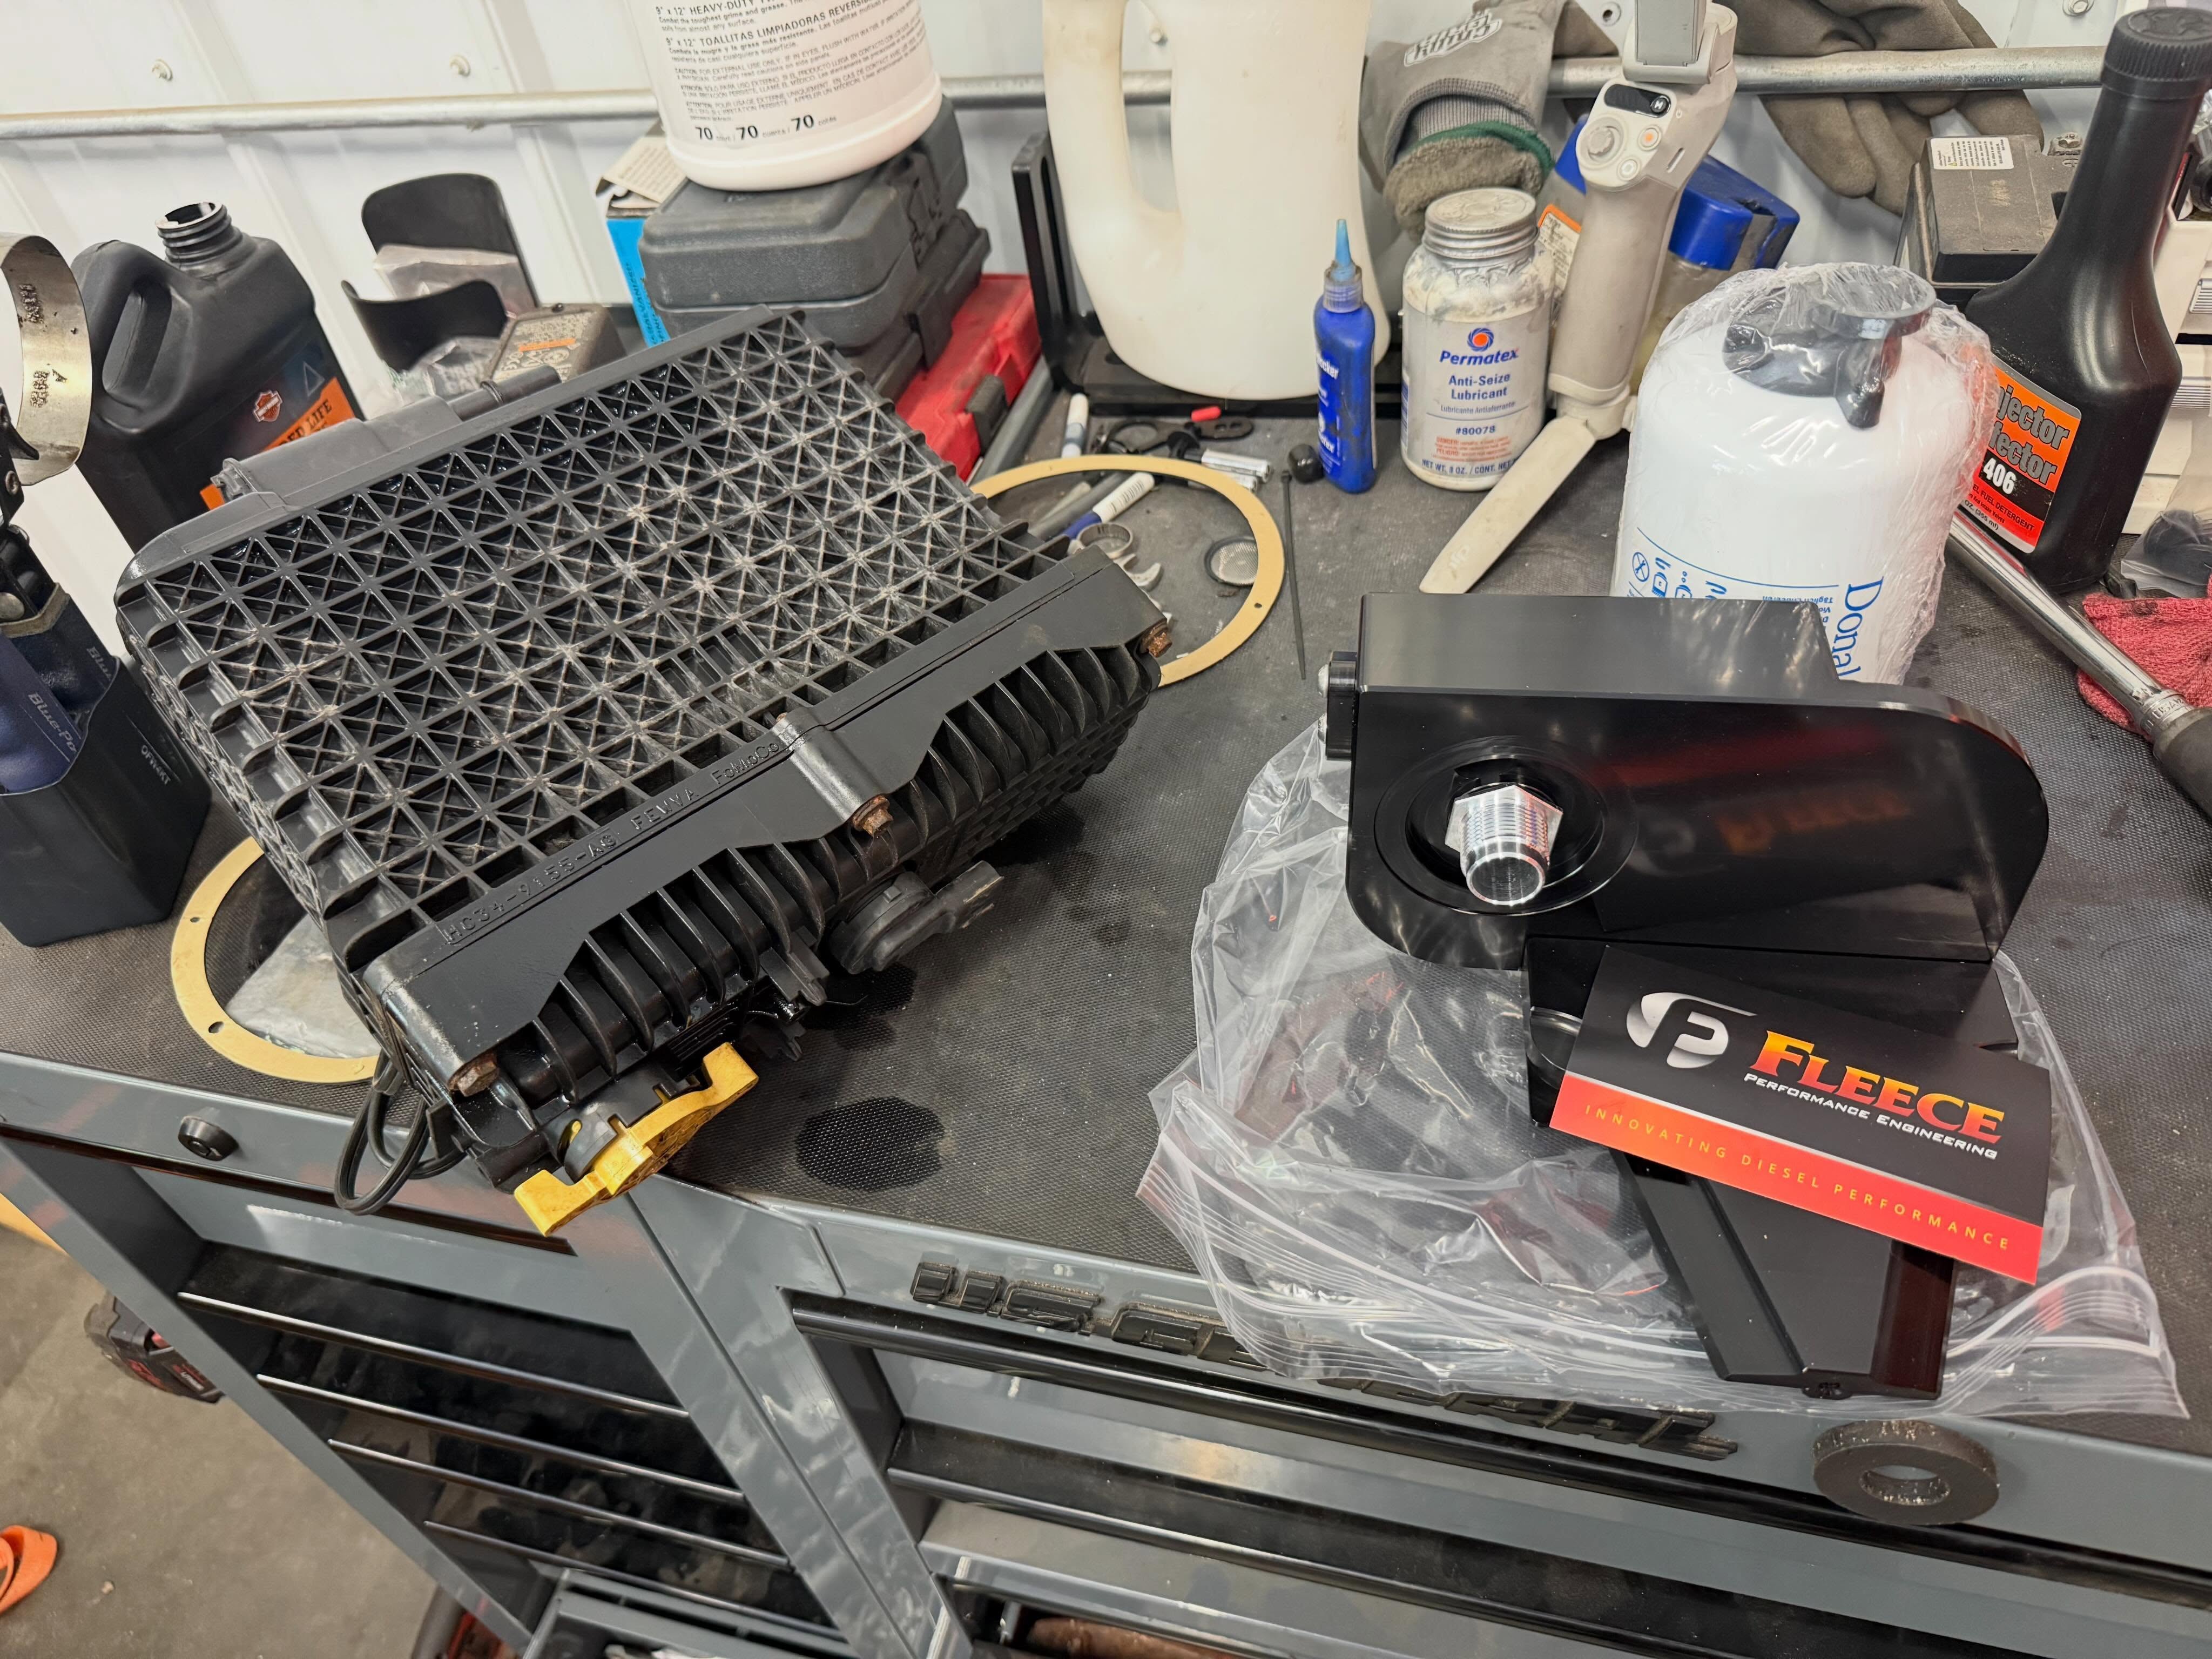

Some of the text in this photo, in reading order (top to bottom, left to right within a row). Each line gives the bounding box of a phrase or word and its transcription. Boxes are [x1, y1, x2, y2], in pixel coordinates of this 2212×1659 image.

[699, 31, 754, 46] TOALLITAS
[757, 12, 826, 39] LIMPIADORAS
[791, 114, 814, 132] 70
[695, 126, 713, 140] 70
[736, 125, 758, 140] 70
[1439, 350, 1519, 366] Permatex
[1448, 373, 1511, 386] Anti-Seize
[1451, 387, 1508, 400] Lubricant
[306, 399, 332, 430] LIFE
[1440, 401, 1516, 414] Lubricante Antiaferrante
[1455, 425, 1495, 435] #80078
[1422, 459, 1433, 468] NET
[1435, 463, 1447, 472] WT.
[1455, 466, 1468, 474] OZ.
[1474, 465, 1495, 474] CONT.
[1498, 460, 1511, 469] NET
[1983, 457, 2017, 494] 406
[1981, 490, 1995, 507] FUEL
[1995, 502, 2035, 531] DETERGENT
[710, 742, 780, 785] FoMoCo
[1750, 1030, 2005, 1144] FLEECE
[1744, 1073, 1998, 1161] PERFORMANCE ENGINEERING
[1584, 1104, 2010, 1251] INNOVATING DIESEL PERFORMANCE
